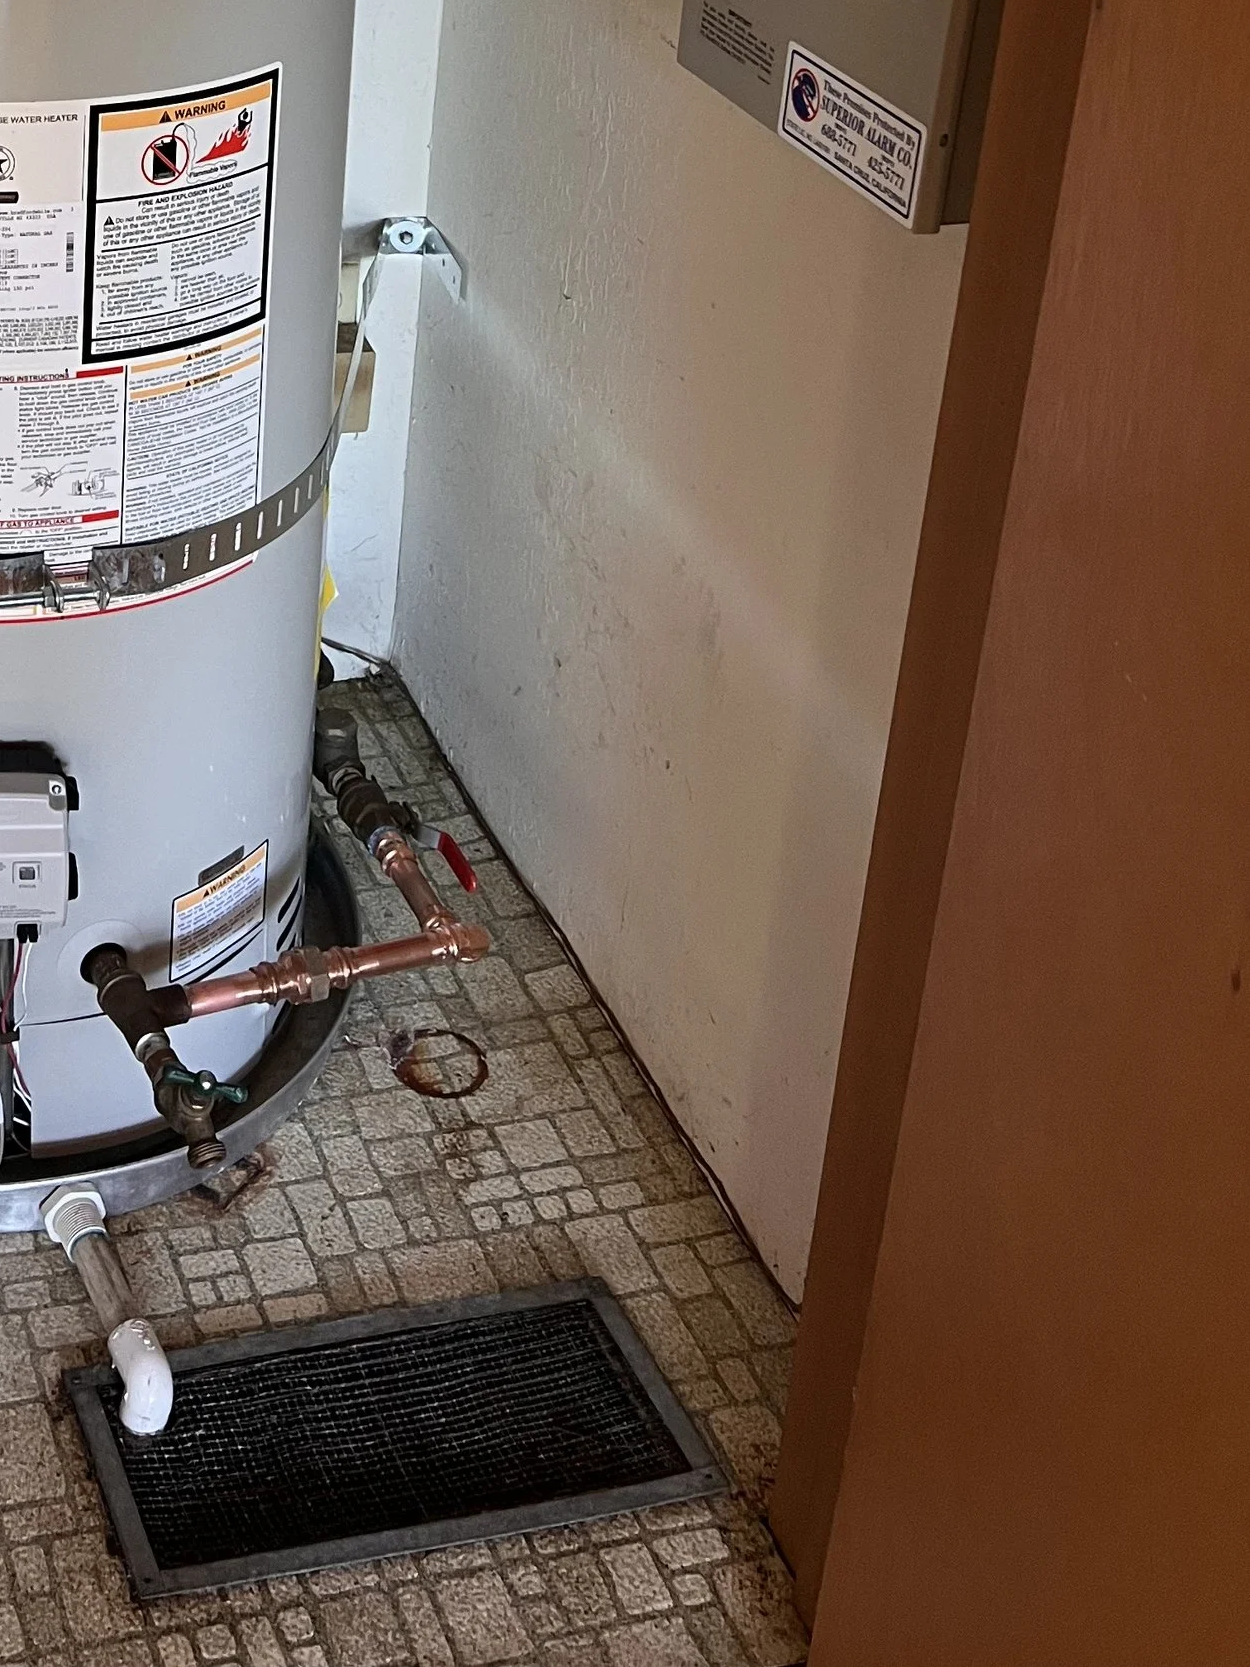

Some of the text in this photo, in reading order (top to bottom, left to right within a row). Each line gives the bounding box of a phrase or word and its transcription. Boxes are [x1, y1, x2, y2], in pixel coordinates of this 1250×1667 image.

[11, 116, 41, 124] WATER
[44, 114, 78, 122] HEATER
[174, 101, 226, 120] WARNING
[823, 79, 842, 102] These
[842, 93, 872, 119] Premises
[873, 112, 905, 140] Protected
[821, 95, 865, 136] SUPERIOR
[865, 128, 894, 158] ALARM
[897, 147, 912, 170] CO.
[171, 188, 206, 200] EXPLOSION
[208, 181, 233, 192] HAZARD
[17, 374, 69, 382] INSTRUCTIONS
